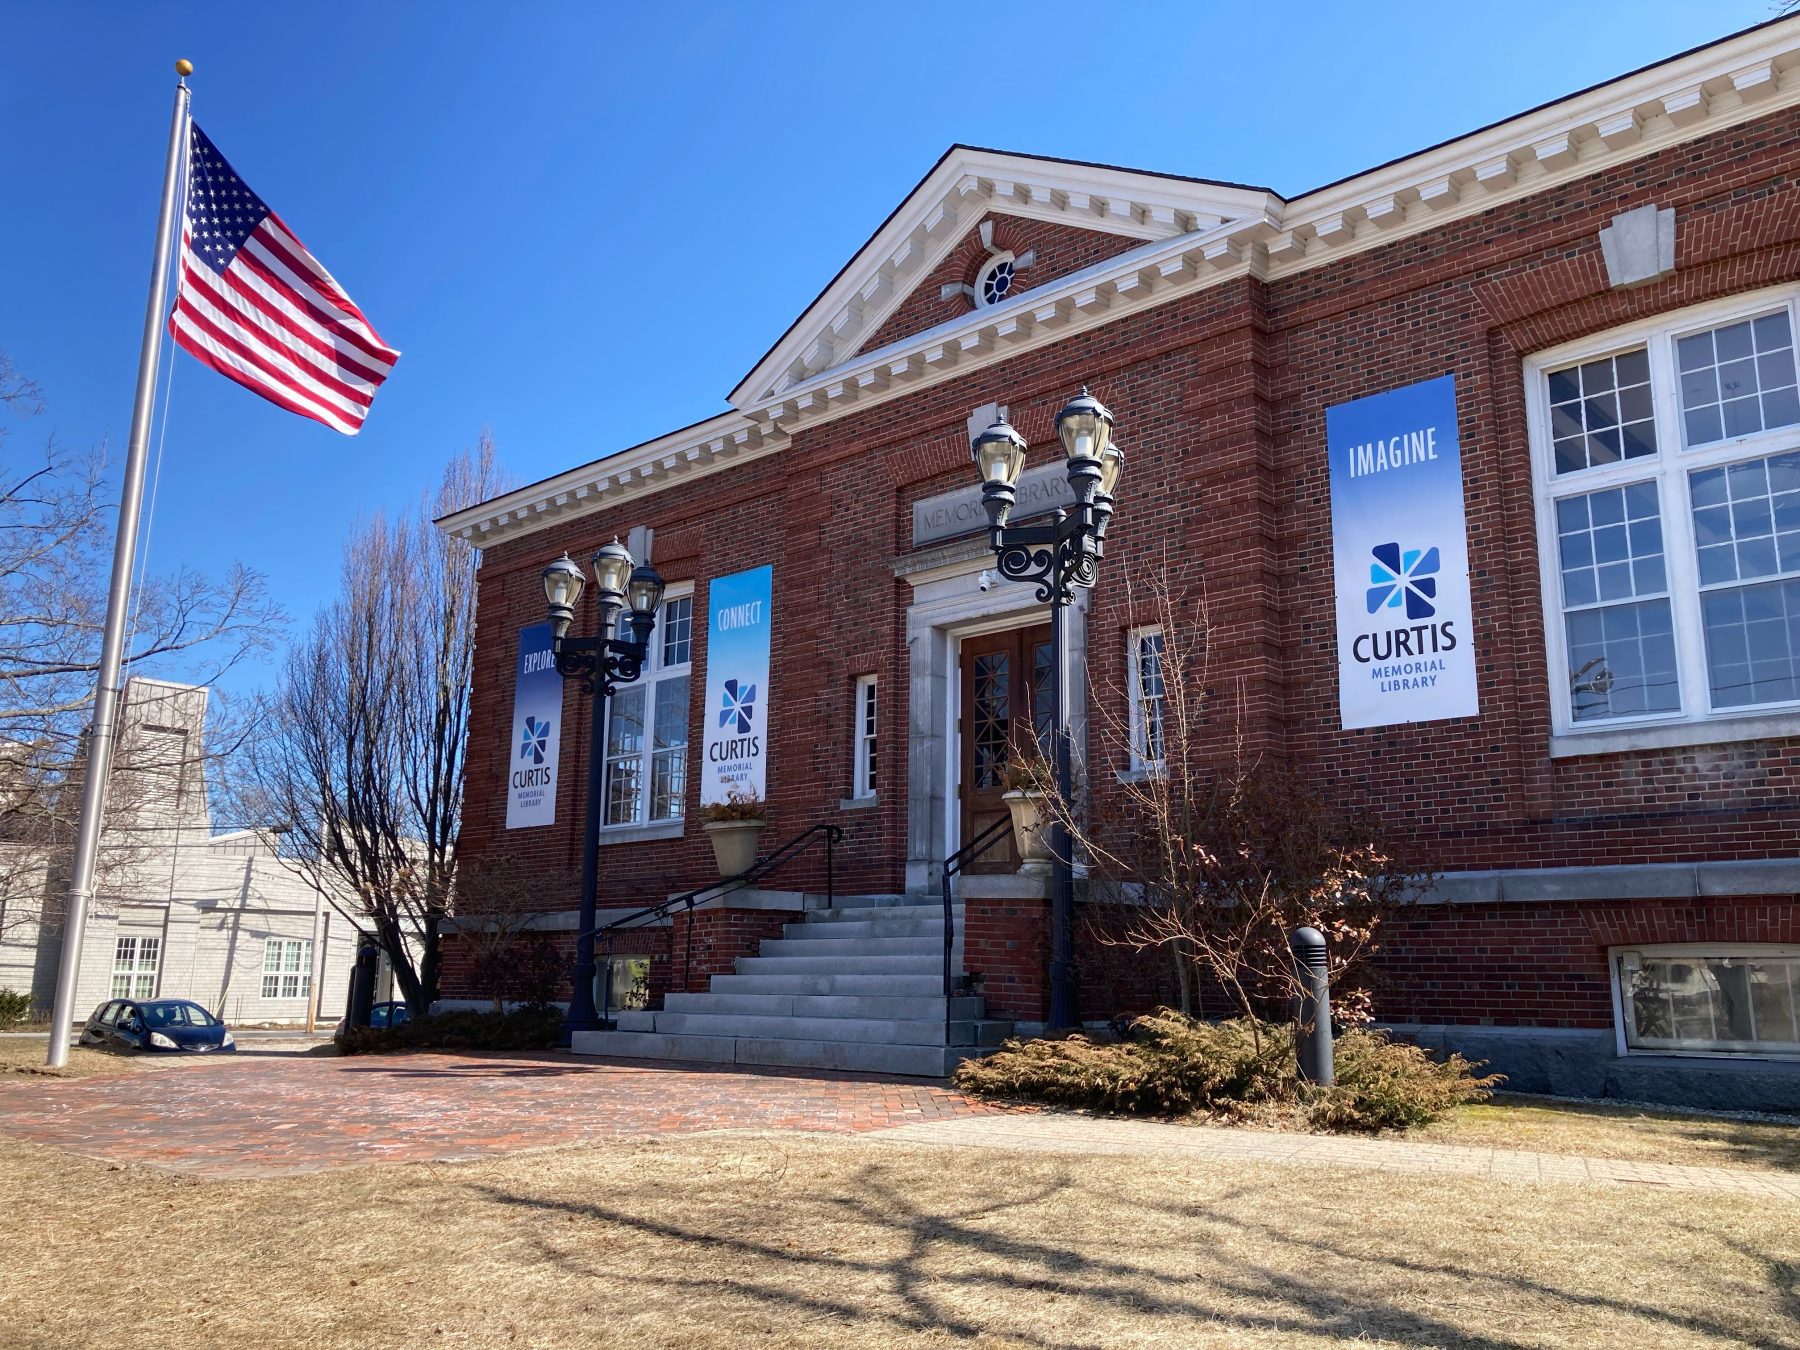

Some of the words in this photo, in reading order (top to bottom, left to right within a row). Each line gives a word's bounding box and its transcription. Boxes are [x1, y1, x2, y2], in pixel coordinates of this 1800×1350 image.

[1349, 427, 1438, 478] IMAGINE
[925, 498, 985, 530] MEMORI
[1015, 475, 1069, 505] IBRARY
[718, 600, 762, 632] CONNECT
[1352, 621, 1457, 663] CURTIS
[523, 649, 556, 675] EXPLORE
[1372, 659, 1446, 680] MEMORIAL
[1380, 674, 1437, 693] LIBRARY
[709, 735, 760, 763] CURTIS
[512, 766, 551, 789] CURTIS
[717, 761, 753, 774] MEMORIAL
[517, 790, 546, 800] MEMORIAL
[520, 799, 542, 809] LIBRARY
